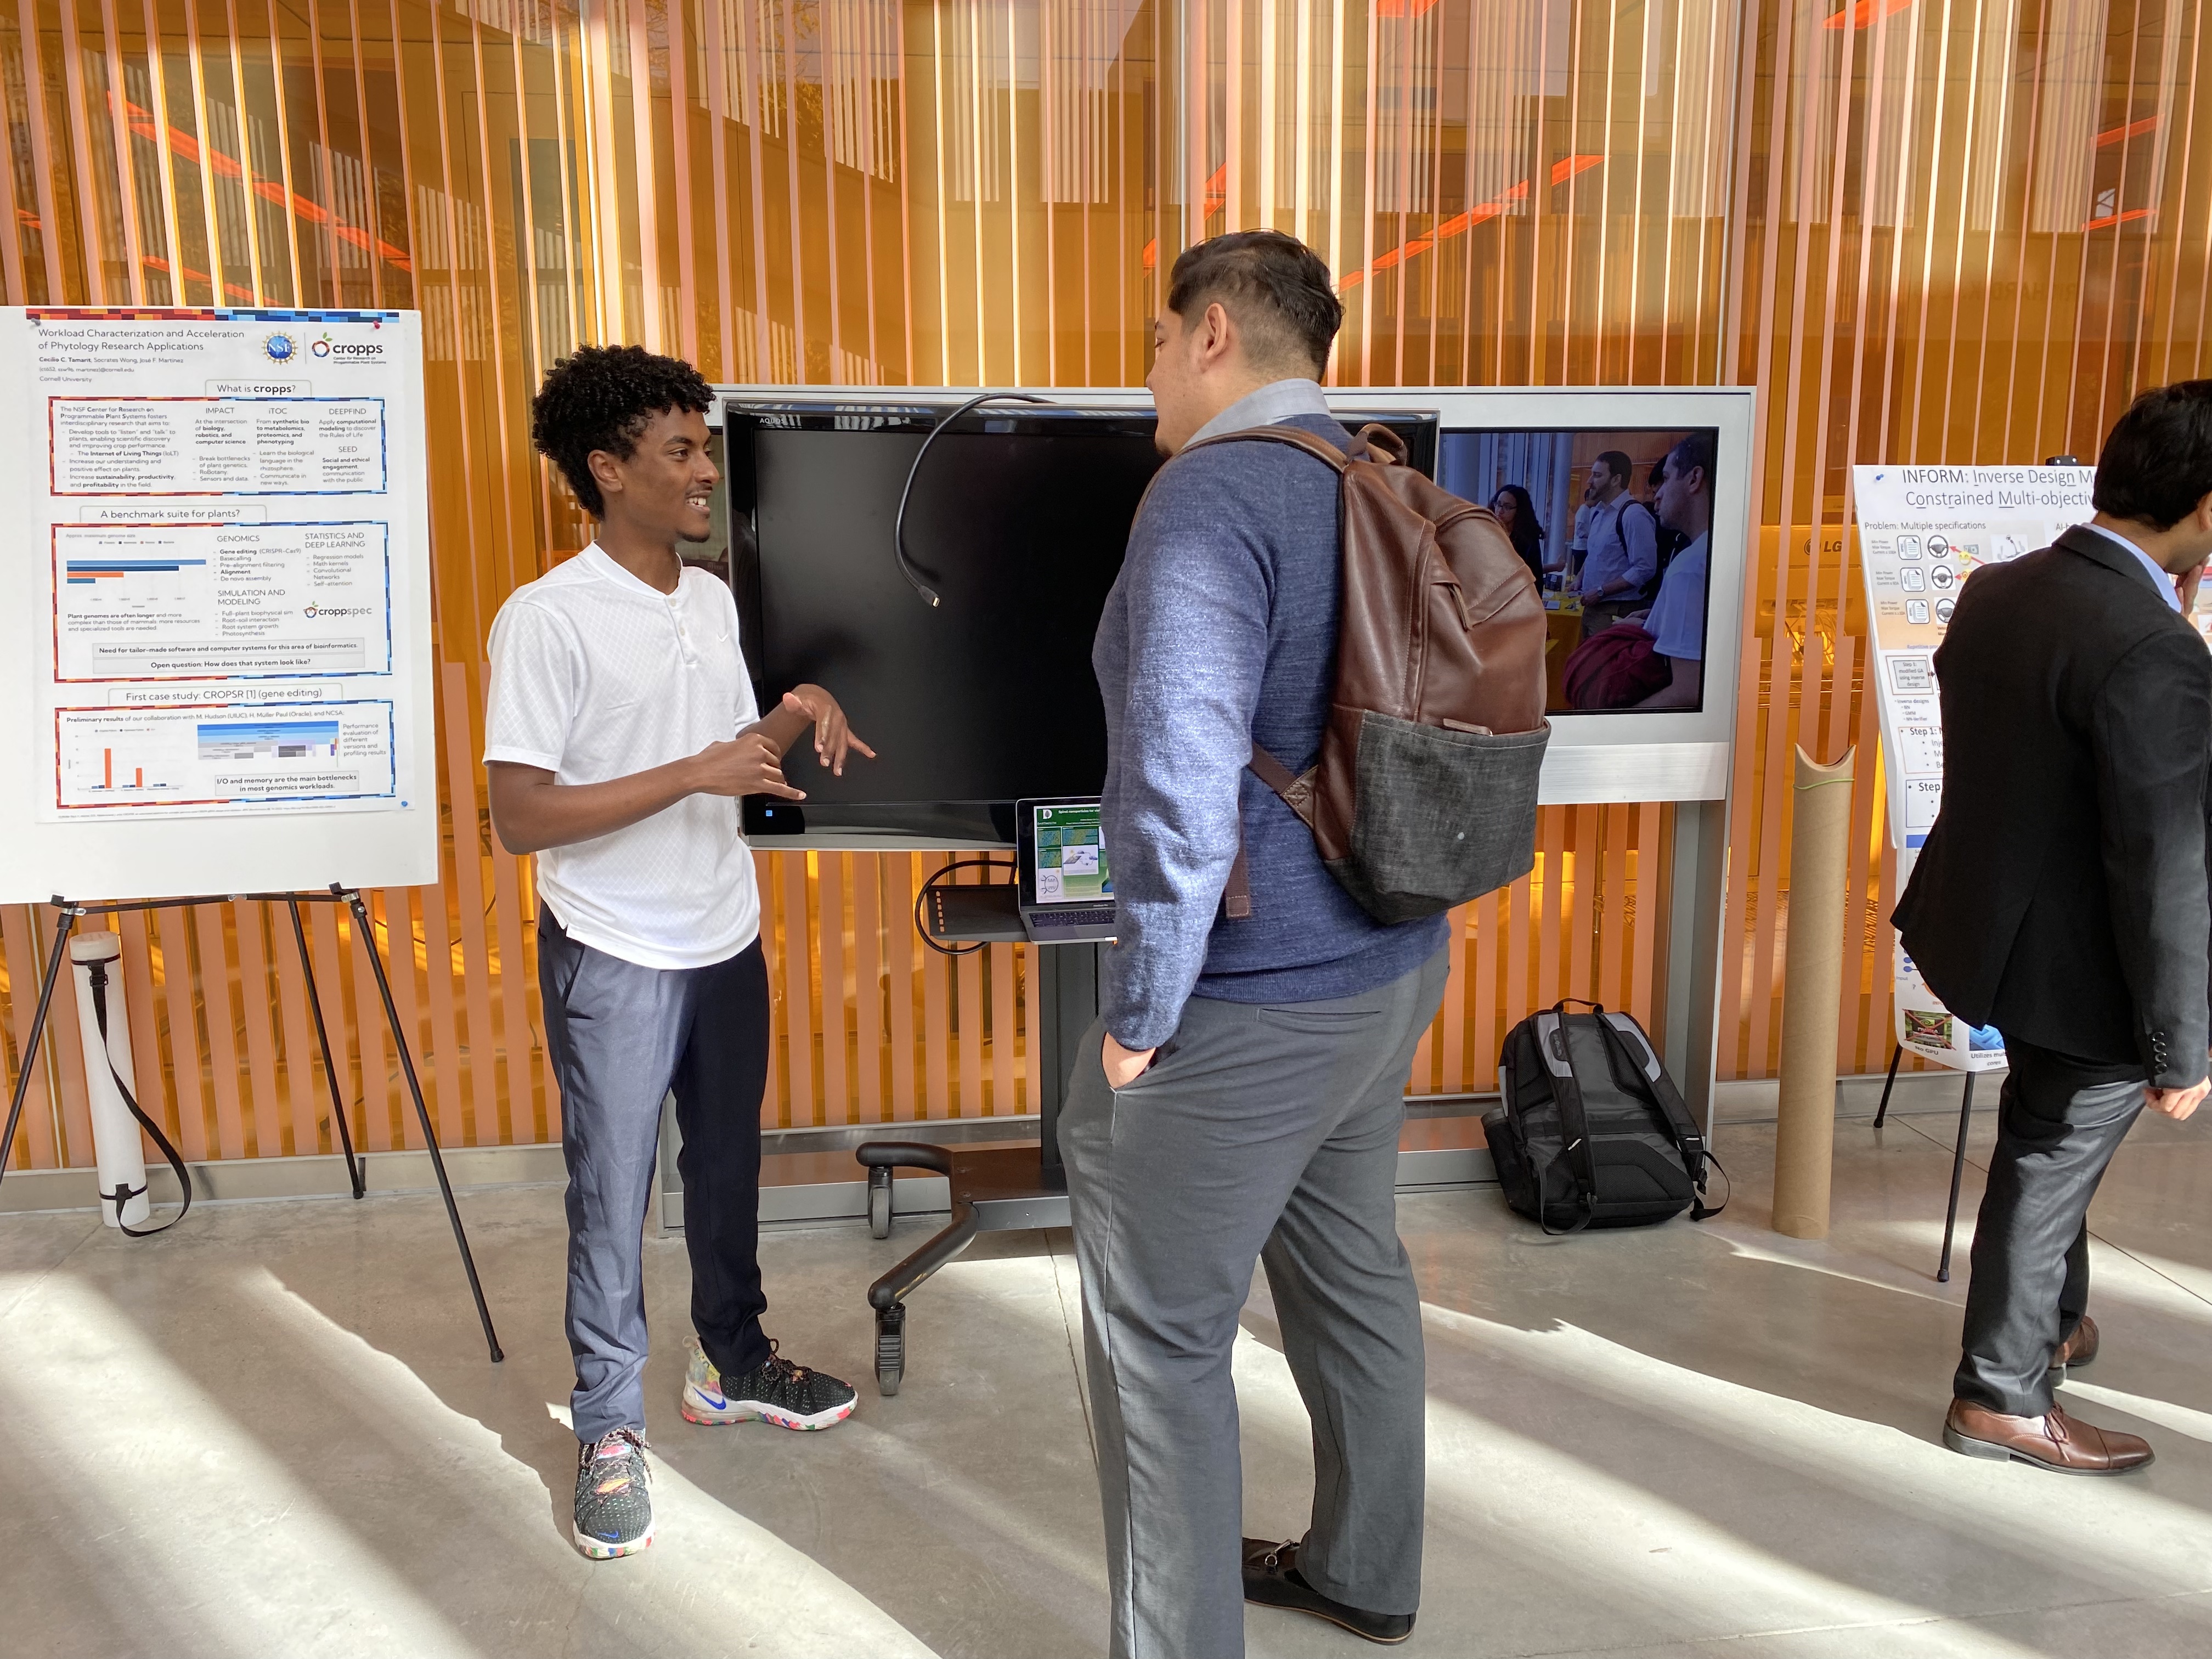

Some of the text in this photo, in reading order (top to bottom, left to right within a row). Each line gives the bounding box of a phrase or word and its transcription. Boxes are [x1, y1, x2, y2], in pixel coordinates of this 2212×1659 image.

[51, 341, 99, 352] Phytology
[146, 342, 204, 352] Applications
[268, 343, 291, 352] NSF
[332, 345, 383, 356] cropps
[253, 385, 295, 394] cropps?
[1903, 469, 1969, 483] INFORM:
[1974, 469, 2024, 486] Inverse
[2028, 469, 2076, 487] Design
[1906, 490, 1994, 509] Constrained
[111, 510, 164, 518] benchmark
[208, 509, 240, 519] plants?
[1864, 521, 1986, 531] Problem: Multiple specifications
[1824, 540, 1842, 552] LG
[318, 608, 371, 617] croppspec
[126, 692, 146, 701] First
[203, 690, 244, 698] CROPSR
[246, 690, 256, 699] [1]
[258, 690, 284, 699] (gene
[287, 688, 321, 698] editing)
[1910, 727, 1938, 737] Step 1:
[1918, 781, 1940, 793] Step
